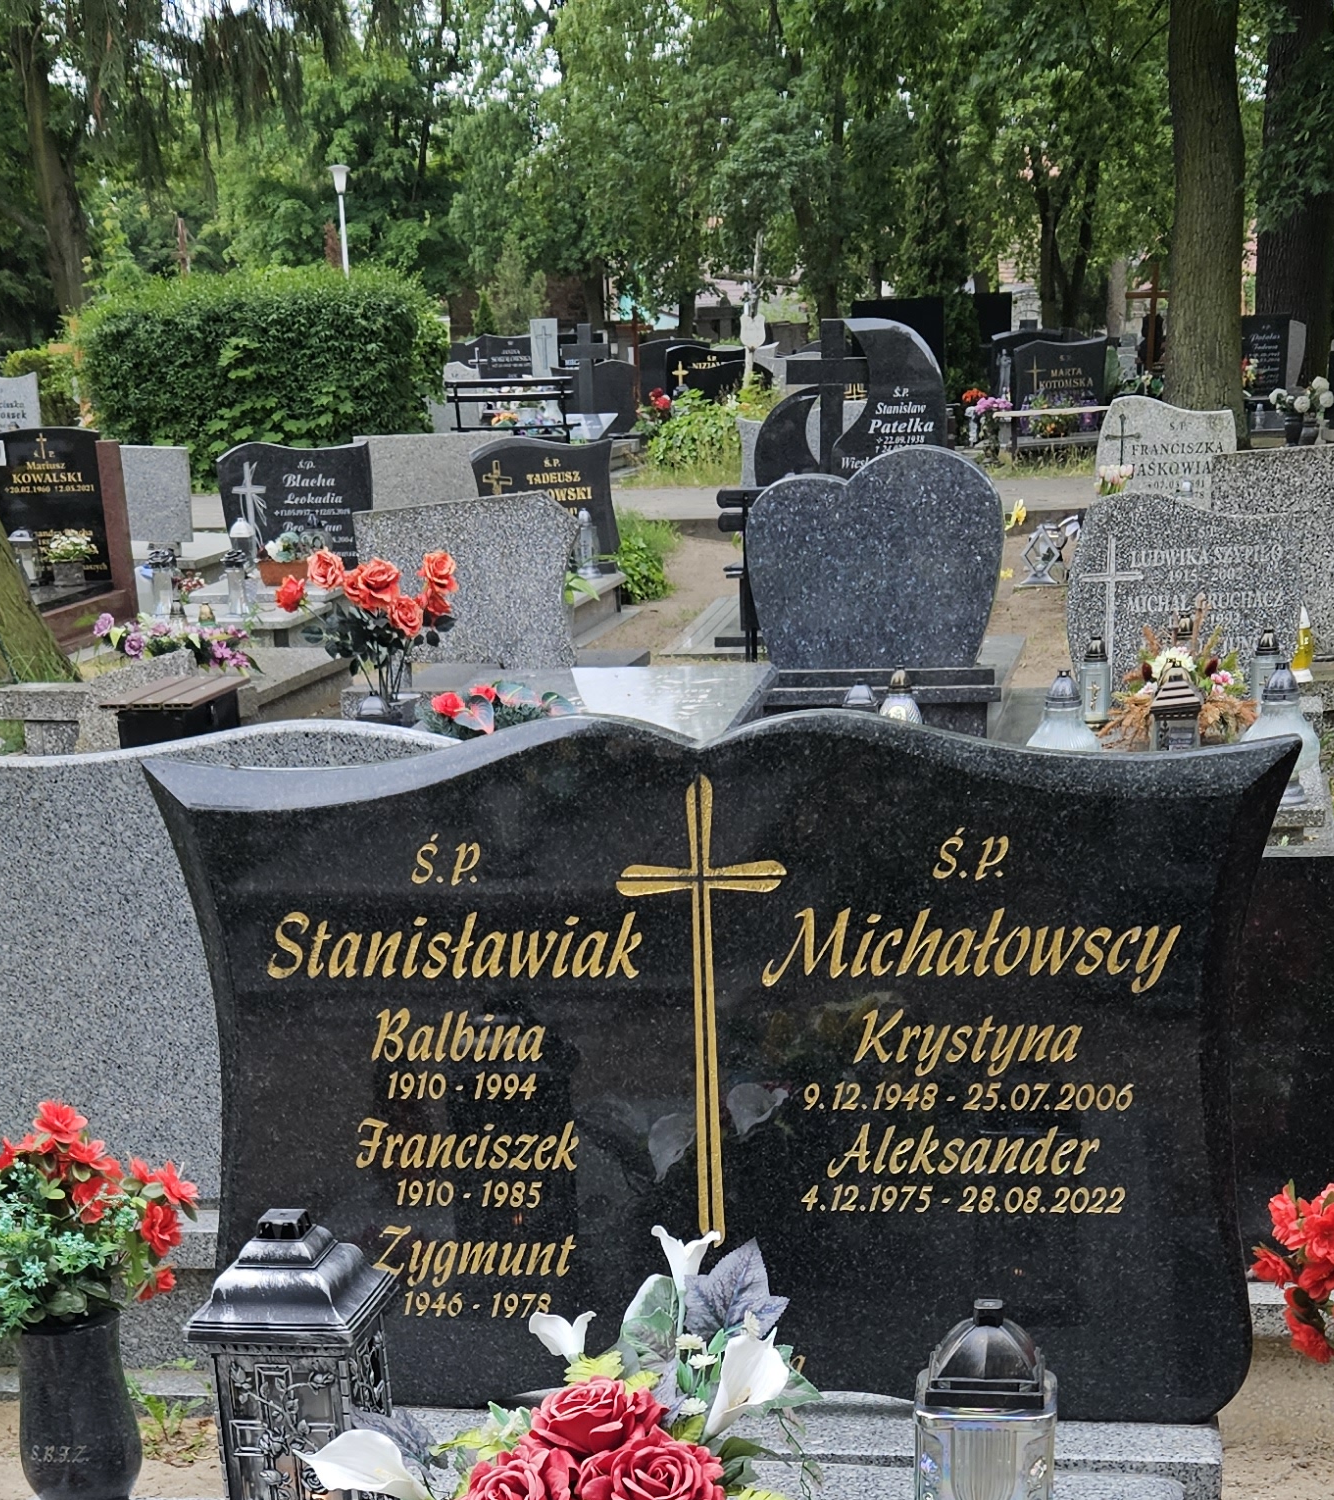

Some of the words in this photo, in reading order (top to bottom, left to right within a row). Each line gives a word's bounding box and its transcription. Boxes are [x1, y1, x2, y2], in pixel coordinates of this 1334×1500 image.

[1050, 367, 1083, 377] MARTA
[867, 417, 936, 434] Patelka
[1131, 441, 1224, 456] FRANCISZKA
[11, 471, 83, 484] KOWALSKI
[26, 461, 66, 470] Mariusz
[282, 473, 336, 487] Blacha
[526, 471, 581, 485] TADEUSZ
[284, 492, 344, 504] Leokadia
[1130, 548, 1210, 568] LUDWIKA
[411, 833, 481, 886] Ś.P.
[932, 827, 1010, 880] Ś.P.
[267, 911, 644, 979] Stanisławiak
[761, 907, 1182, 994] Michałowscy
[371, 1007, 546, 1062] Balbina
[853, 1008, 1083, 1077] Krystyna
[387, 1071, 447, 1100] 1910
[474, 1071, 537, 1100] 1994
[803, 1081, 940, 1111] 9.12.1948
[962, 1082, 1135, 1112] 25.07.2006
[355, 1117, 580, 1171] Franciszek
[827, 1122, 1101, 1179] Aleksander
[396, 1179, 455, 1207] 1910
[481, 1180, 543, 1209] 1985
[800, 1184, 933, 1213] 4.12.1975
[957, 1184, 1127, 1214] 28.08.2022
[372, 1225, 577, 1288] Zygmunt
[403, 1290, 463, 1318] 1946
[491, 1292, 552, 1318] 1978
